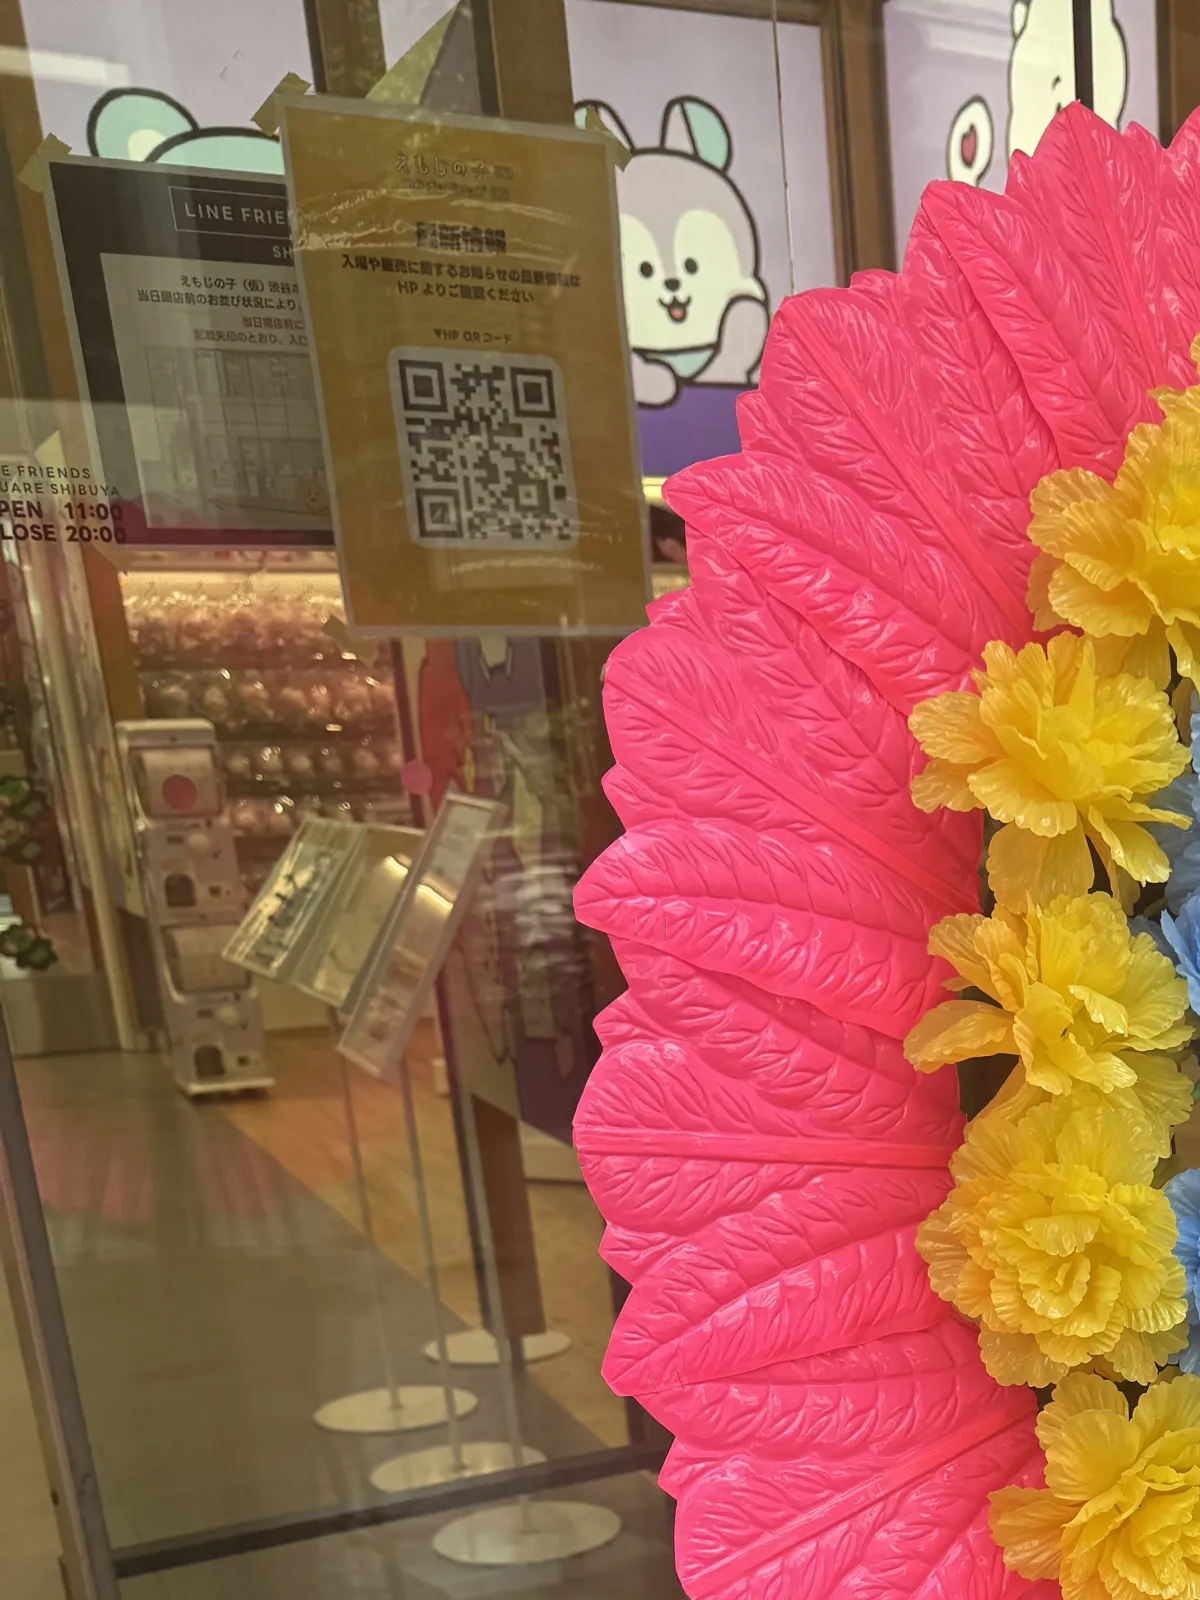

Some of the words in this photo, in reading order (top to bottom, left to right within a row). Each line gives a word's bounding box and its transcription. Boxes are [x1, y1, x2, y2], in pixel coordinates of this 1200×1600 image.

[184, 201, 234, 221] LINE
[240, 207, 290, 225] FRIE
[17, 465, 91, 479] FRIENDS
[51, 483, 120, 497] SHIBUYA
[64, 502, 123, 520] 11:00
[65, 525, 127, 544] 20:00
